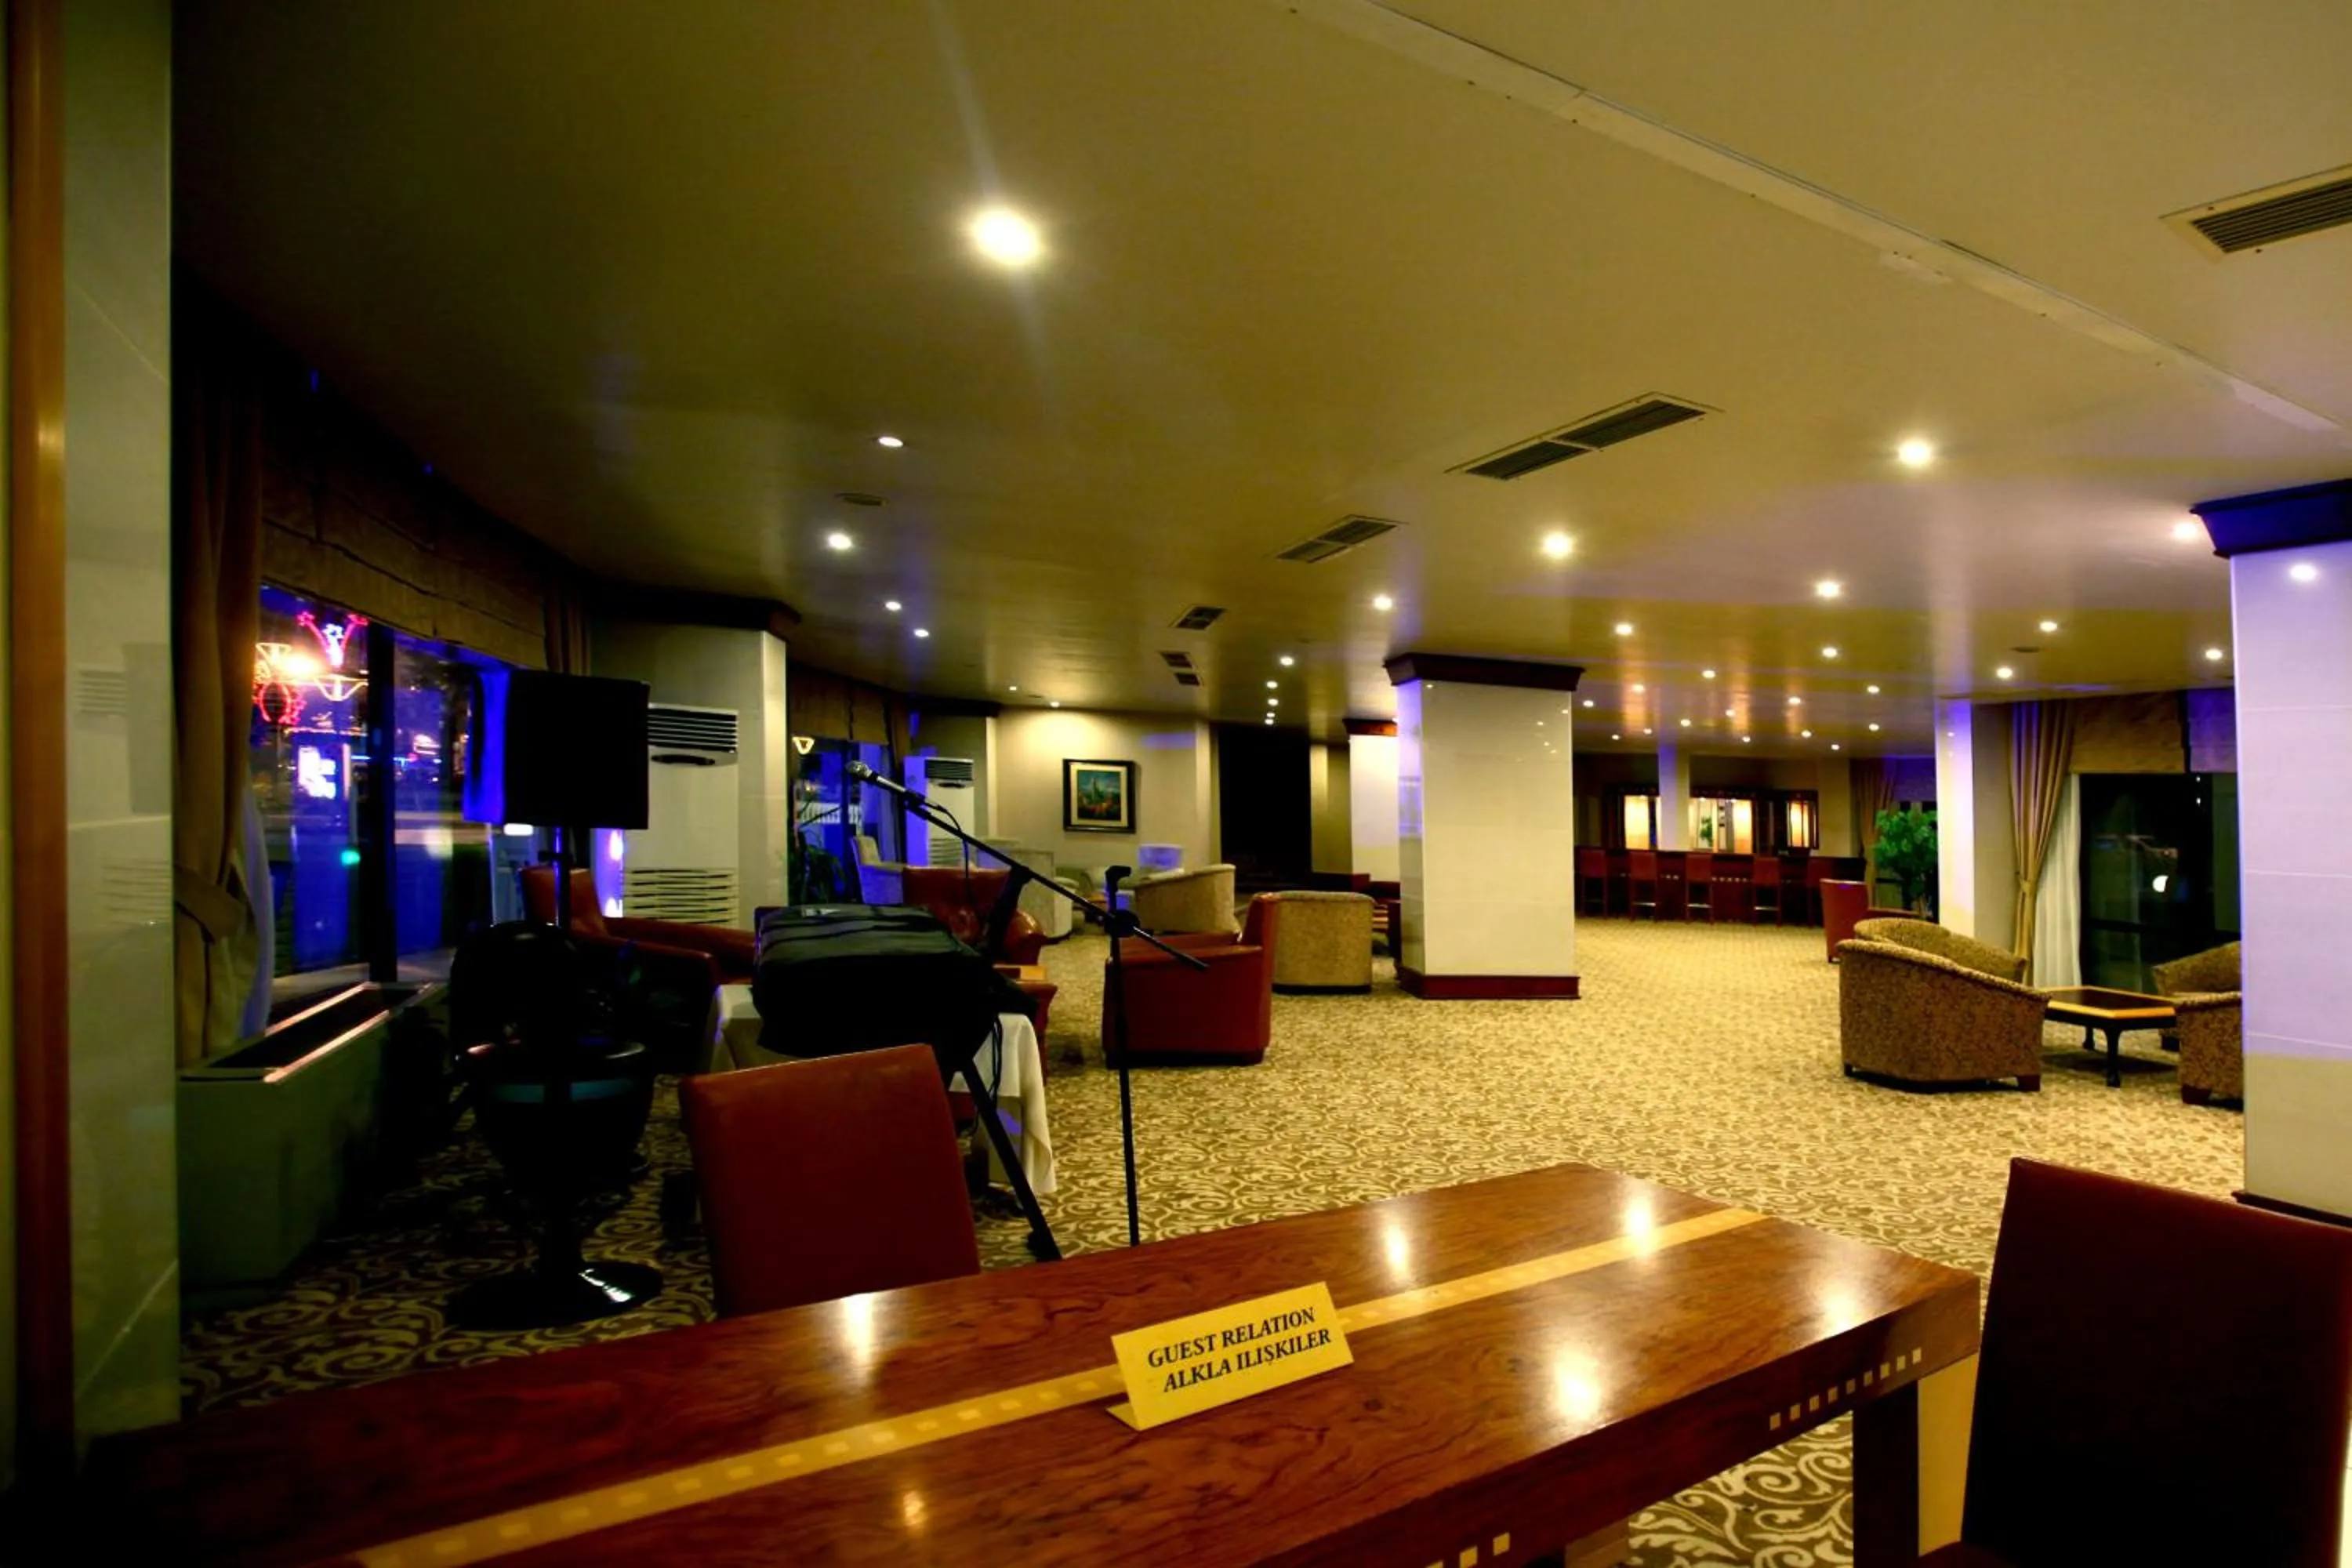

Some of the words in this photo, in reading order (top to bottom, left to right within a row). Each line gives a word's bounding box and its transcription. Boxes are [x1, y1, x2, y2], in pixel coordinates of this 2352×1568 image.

[1148, 1334, 1216, 1368] GUEST
[1221, 1306, 1316, 1348] RELATION
[1163, 1358, 1232, 1392] ALKLA
